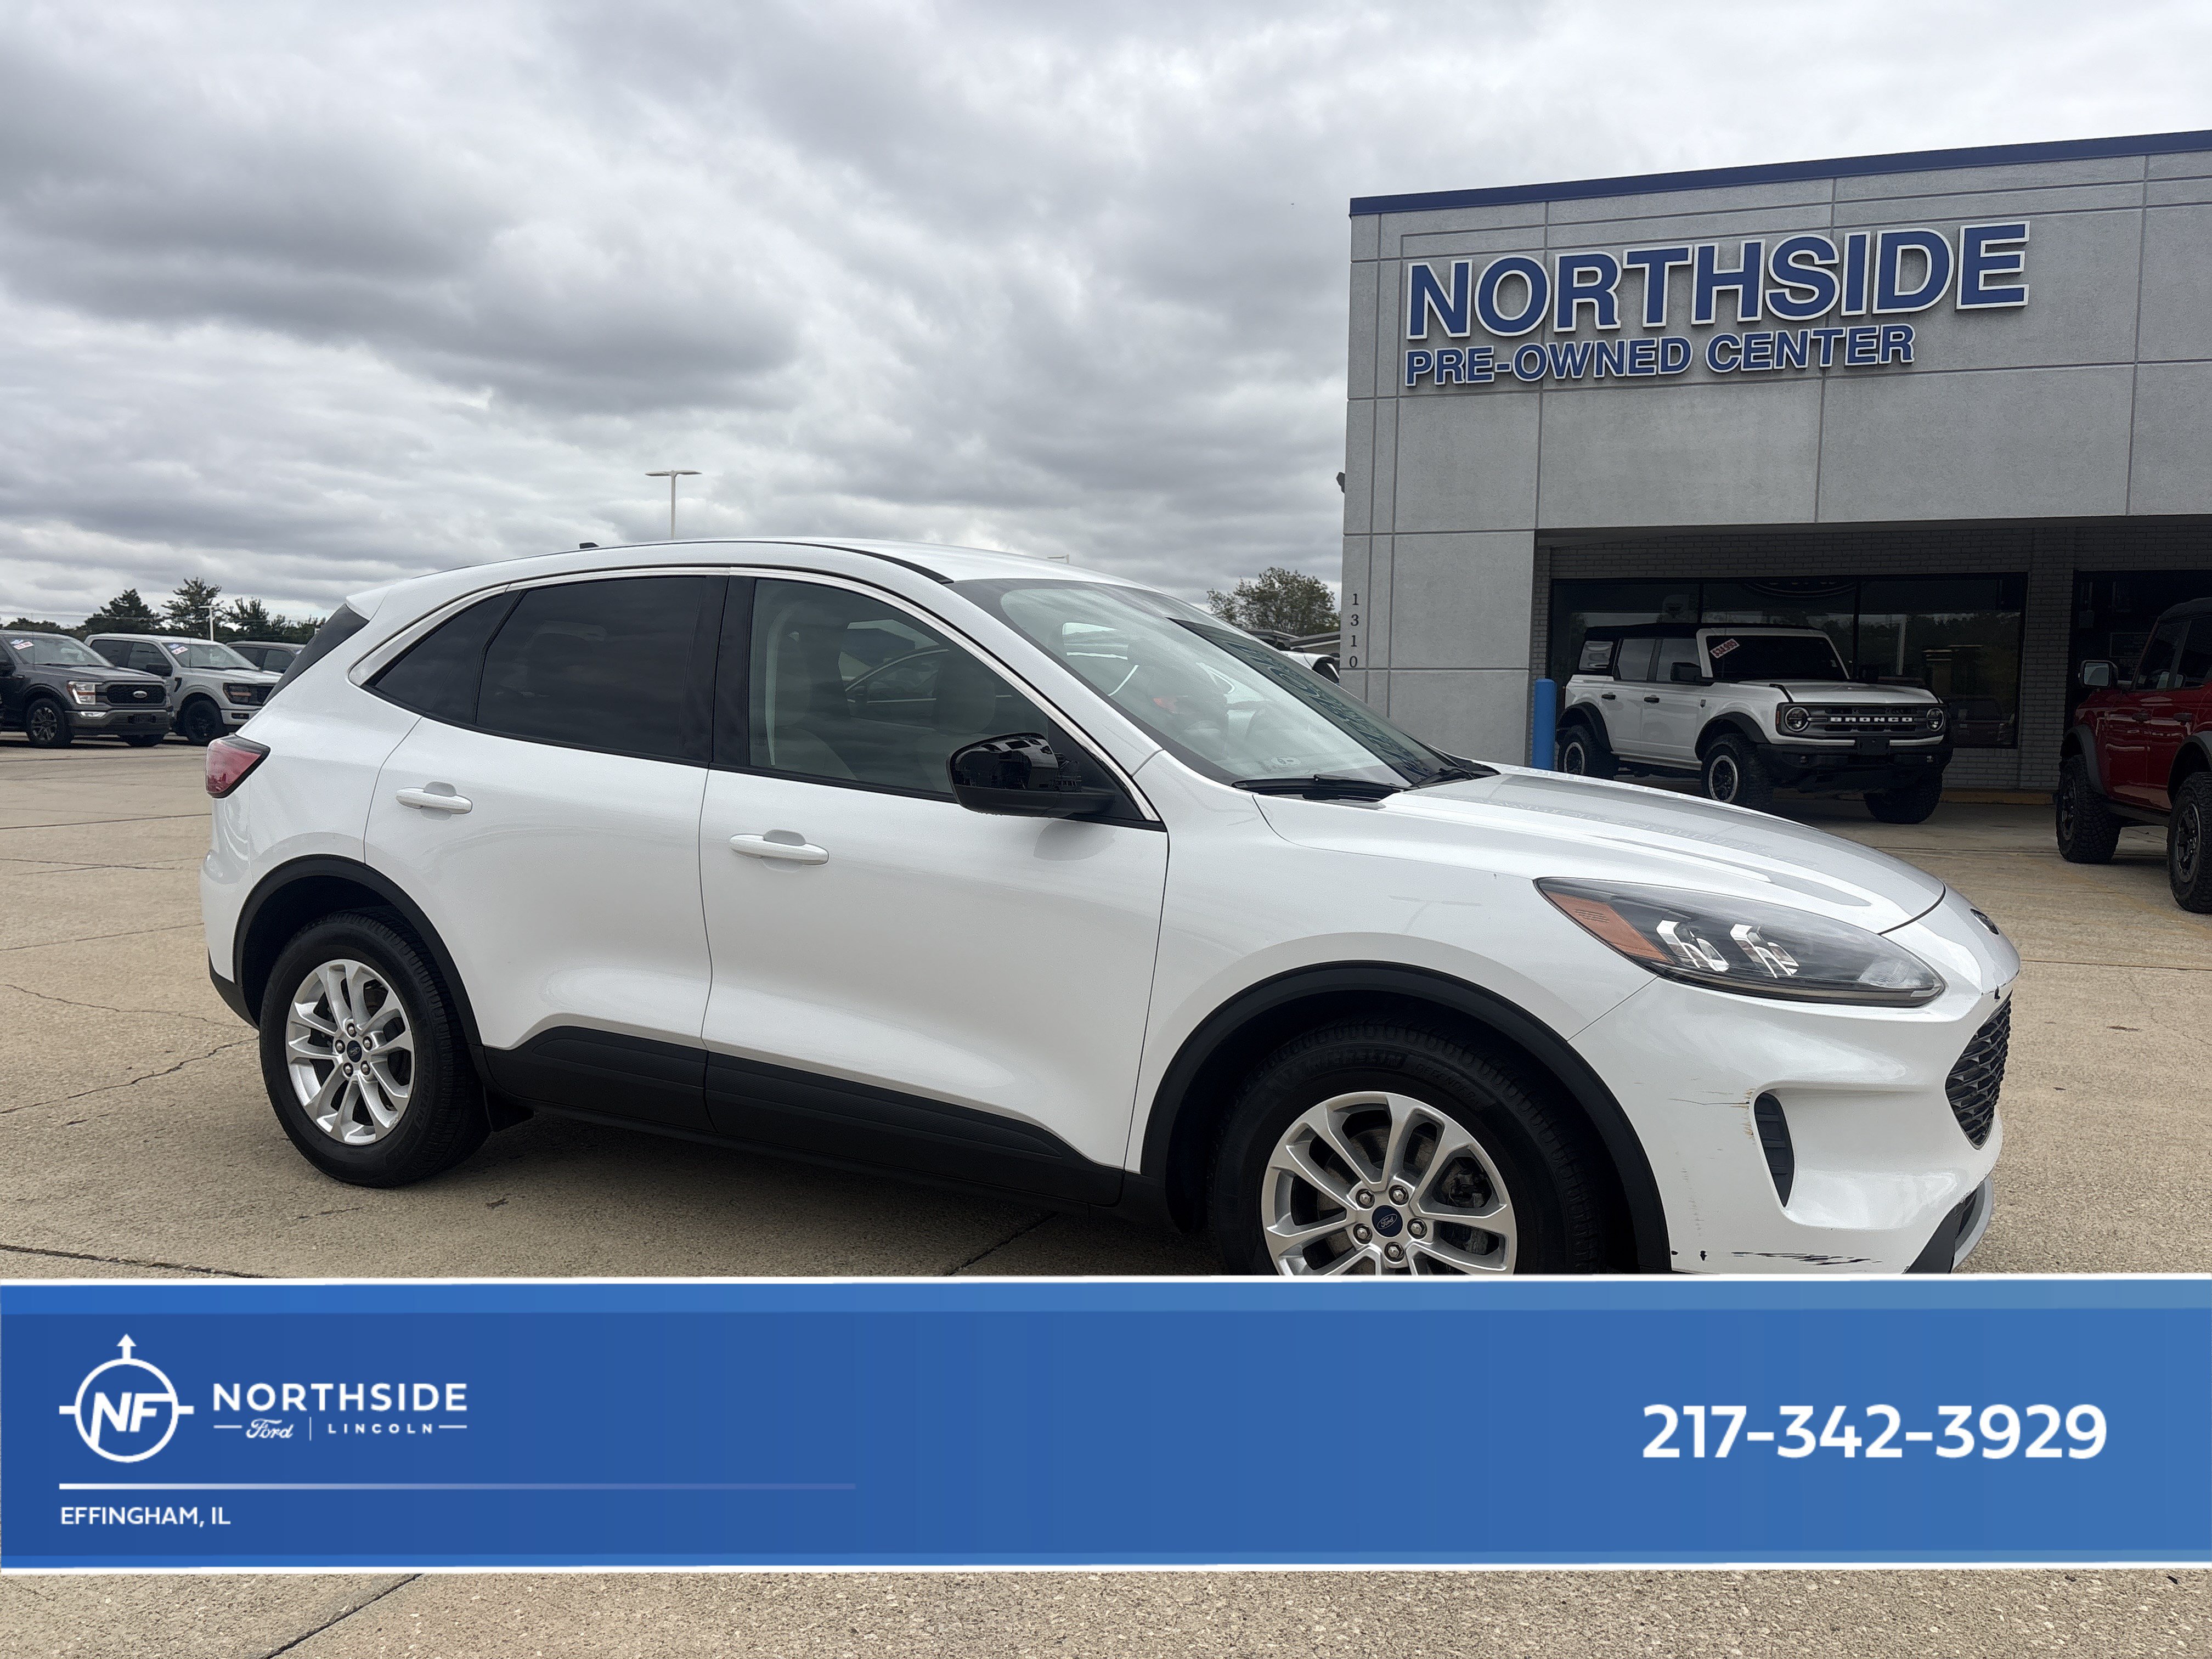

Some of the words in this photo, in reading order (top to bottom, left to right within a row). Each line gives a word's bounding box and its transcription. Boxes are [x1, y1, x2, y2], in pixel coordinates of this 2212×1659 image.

[1406, 221, 2030, 340] NORTHSIDE
[1405, 336, 1693, 386] PRE-OWNED
[1705, 323, 1916, 373] CENTER
[1348, 592, 1359, 668] 1310
[1380, 1216, 1394, 1228] Ford
